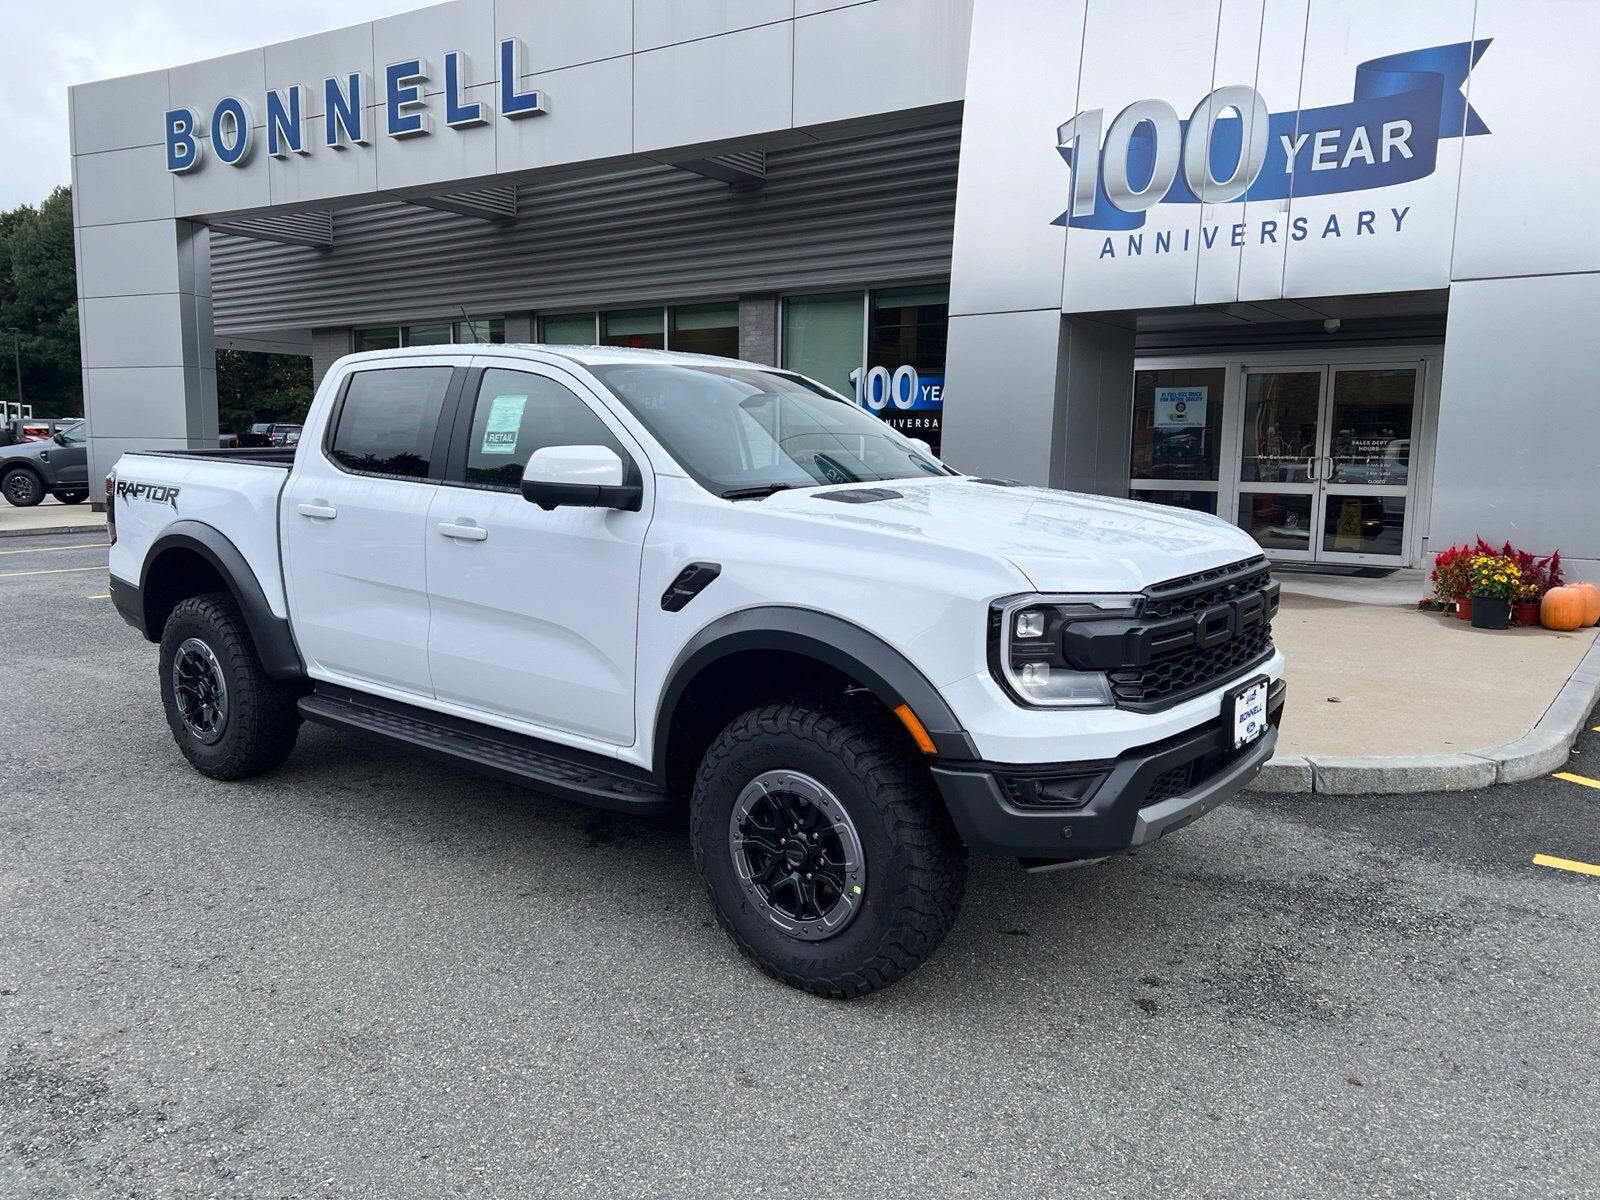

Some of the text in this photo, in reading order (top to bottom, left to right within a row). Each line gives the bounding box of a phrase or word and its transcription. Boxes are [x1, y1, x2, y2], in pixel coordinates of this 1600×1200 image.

[165, 38, 546, 173] BONNELL
[1056, 85, 1414, 217] 100 YEAR
[1099, 206, 1411, 259] ANNIVERSARY
[849, 365, 945, 410] 100 YE
[488, 433, 514, 443] RETAIL
[116, 480, 181, 515] RAPTOR
[1239, 704, 1263, 723] BONNELL
